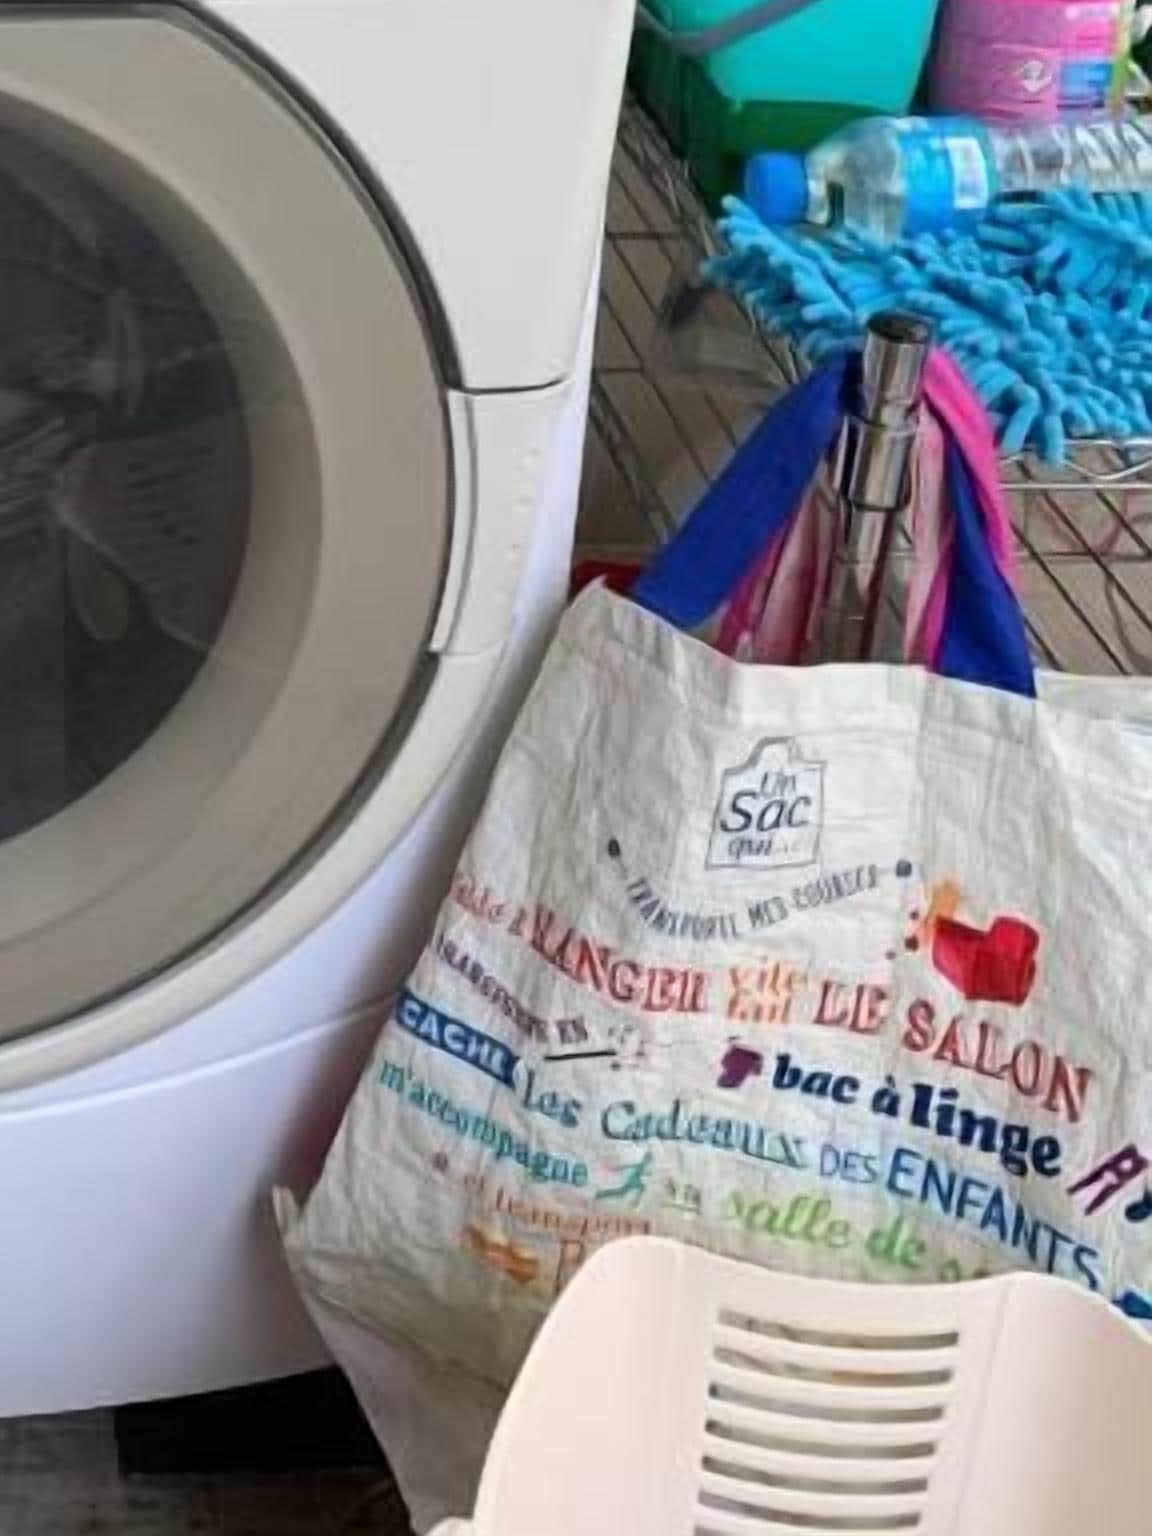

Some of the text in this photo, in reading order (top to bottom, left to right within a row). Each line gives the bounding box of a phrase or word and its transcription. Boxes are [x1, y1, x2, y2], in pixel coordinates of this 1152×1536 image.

[719, 788, 812, 832] Sac
[772, 1052, 1064, 1179] bac à linge
[813, 979, 888, 1034] LE
[902, 998, 1092, 1124] SALON
[381, 1058, 589, 1188] m'accompagne
[868, 1212, 926, 1268] de
[601, 1098, 806, 1169] Cadeaux
[819, 1144, 879, 1183] DES
[886, 1139, 1099, 1292] ENFANTS
